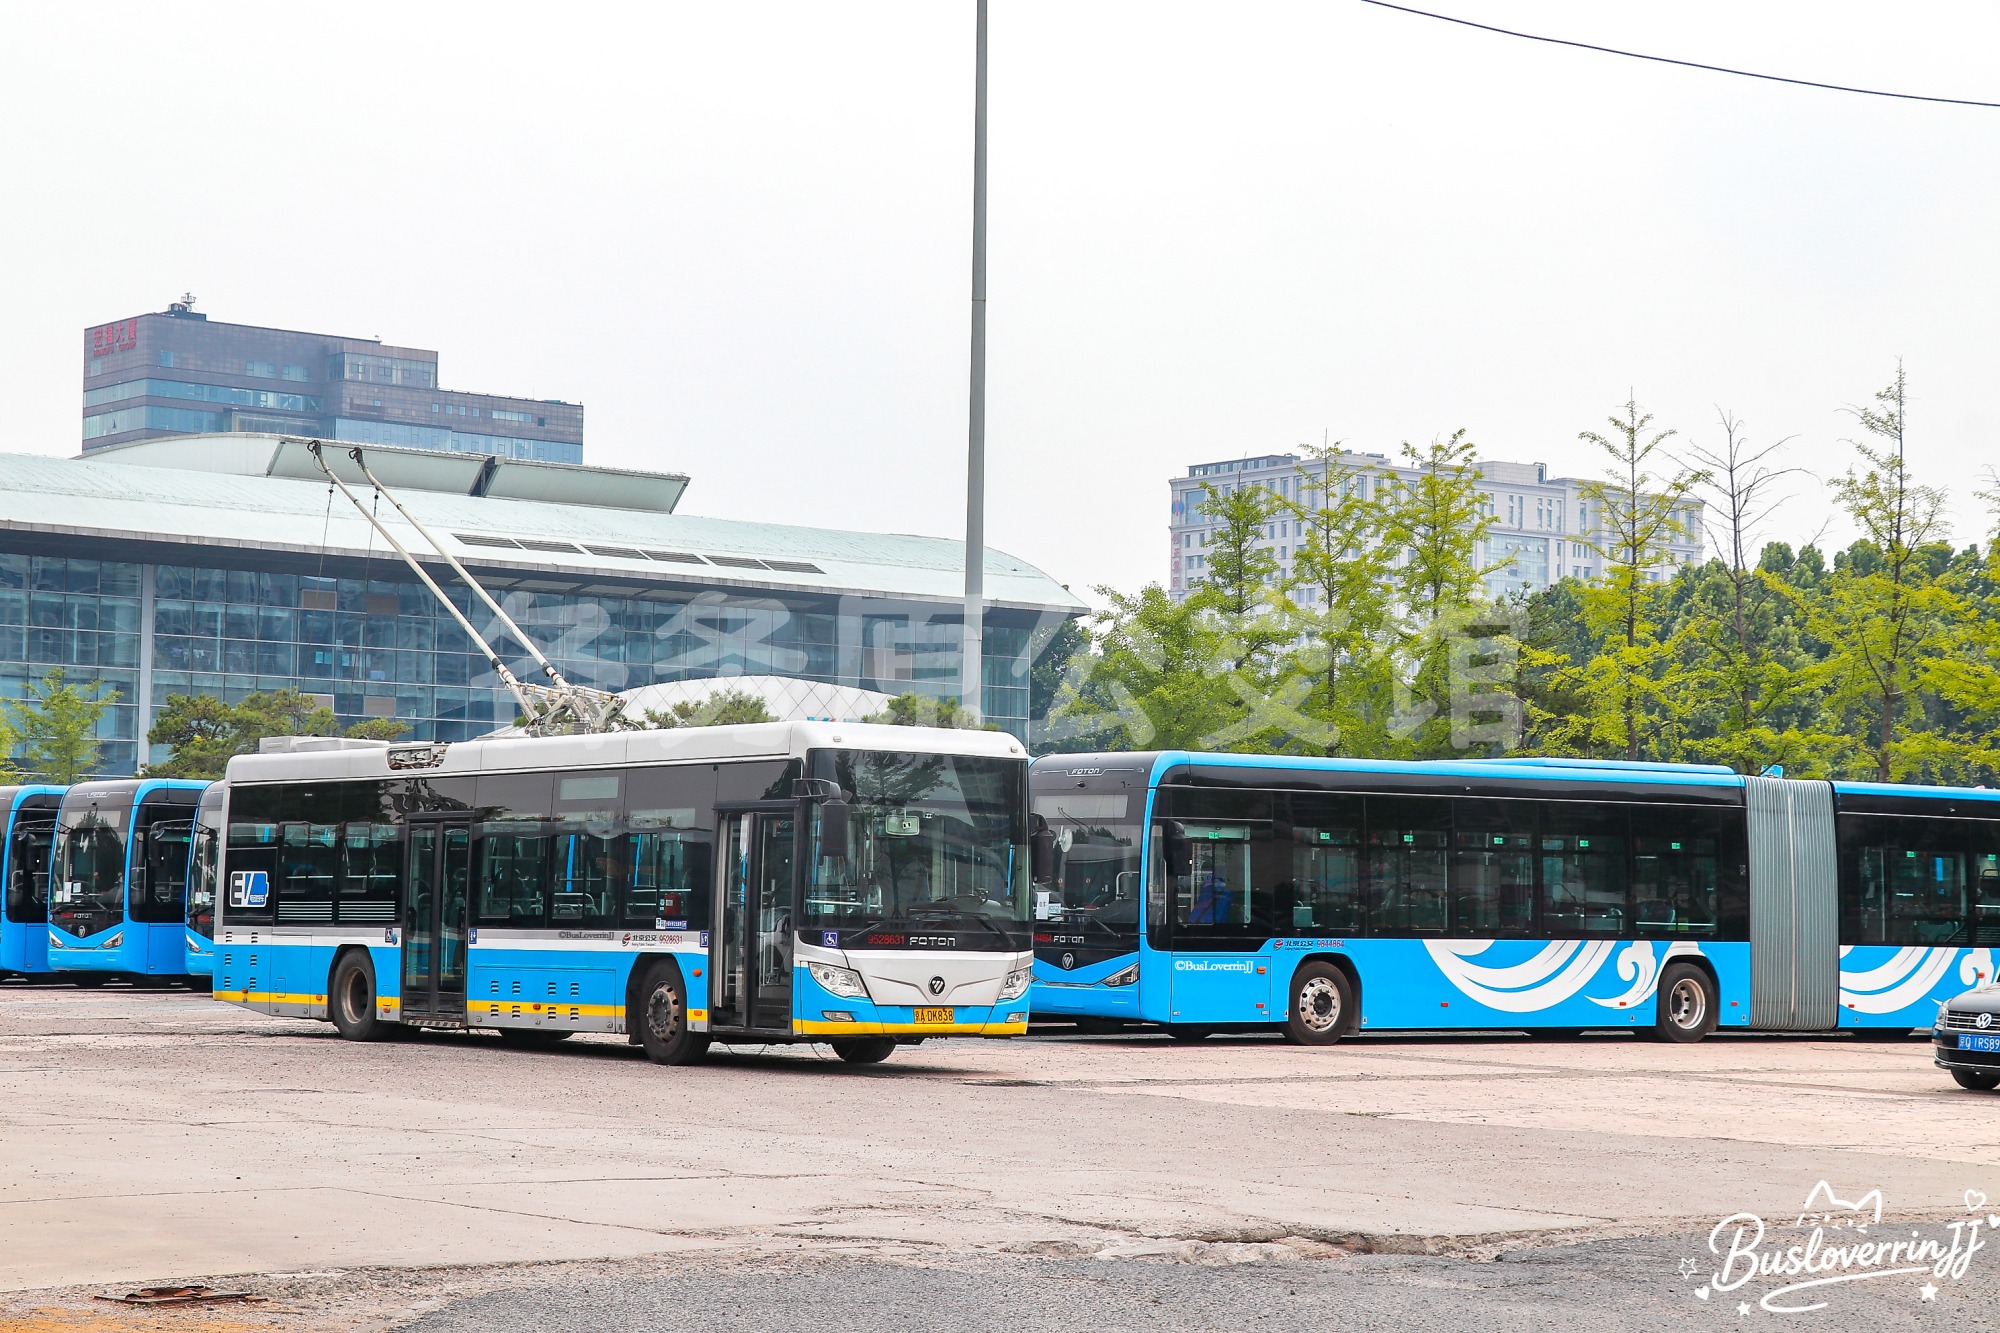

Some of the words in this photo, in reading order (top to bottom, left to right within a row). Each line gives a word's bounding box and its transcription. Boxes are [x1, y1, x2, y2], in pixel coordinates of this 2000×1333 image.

[632, 934, 657, 942] 北京公交
[659, 934, 683, 944] 9528631
[867, 934, 905, 945] 9528631
[909, 936, 956, 946] FOTON
[1053, 935, 1085, 943] FOTON
[1317, 939, 1345, 948] 9844864
